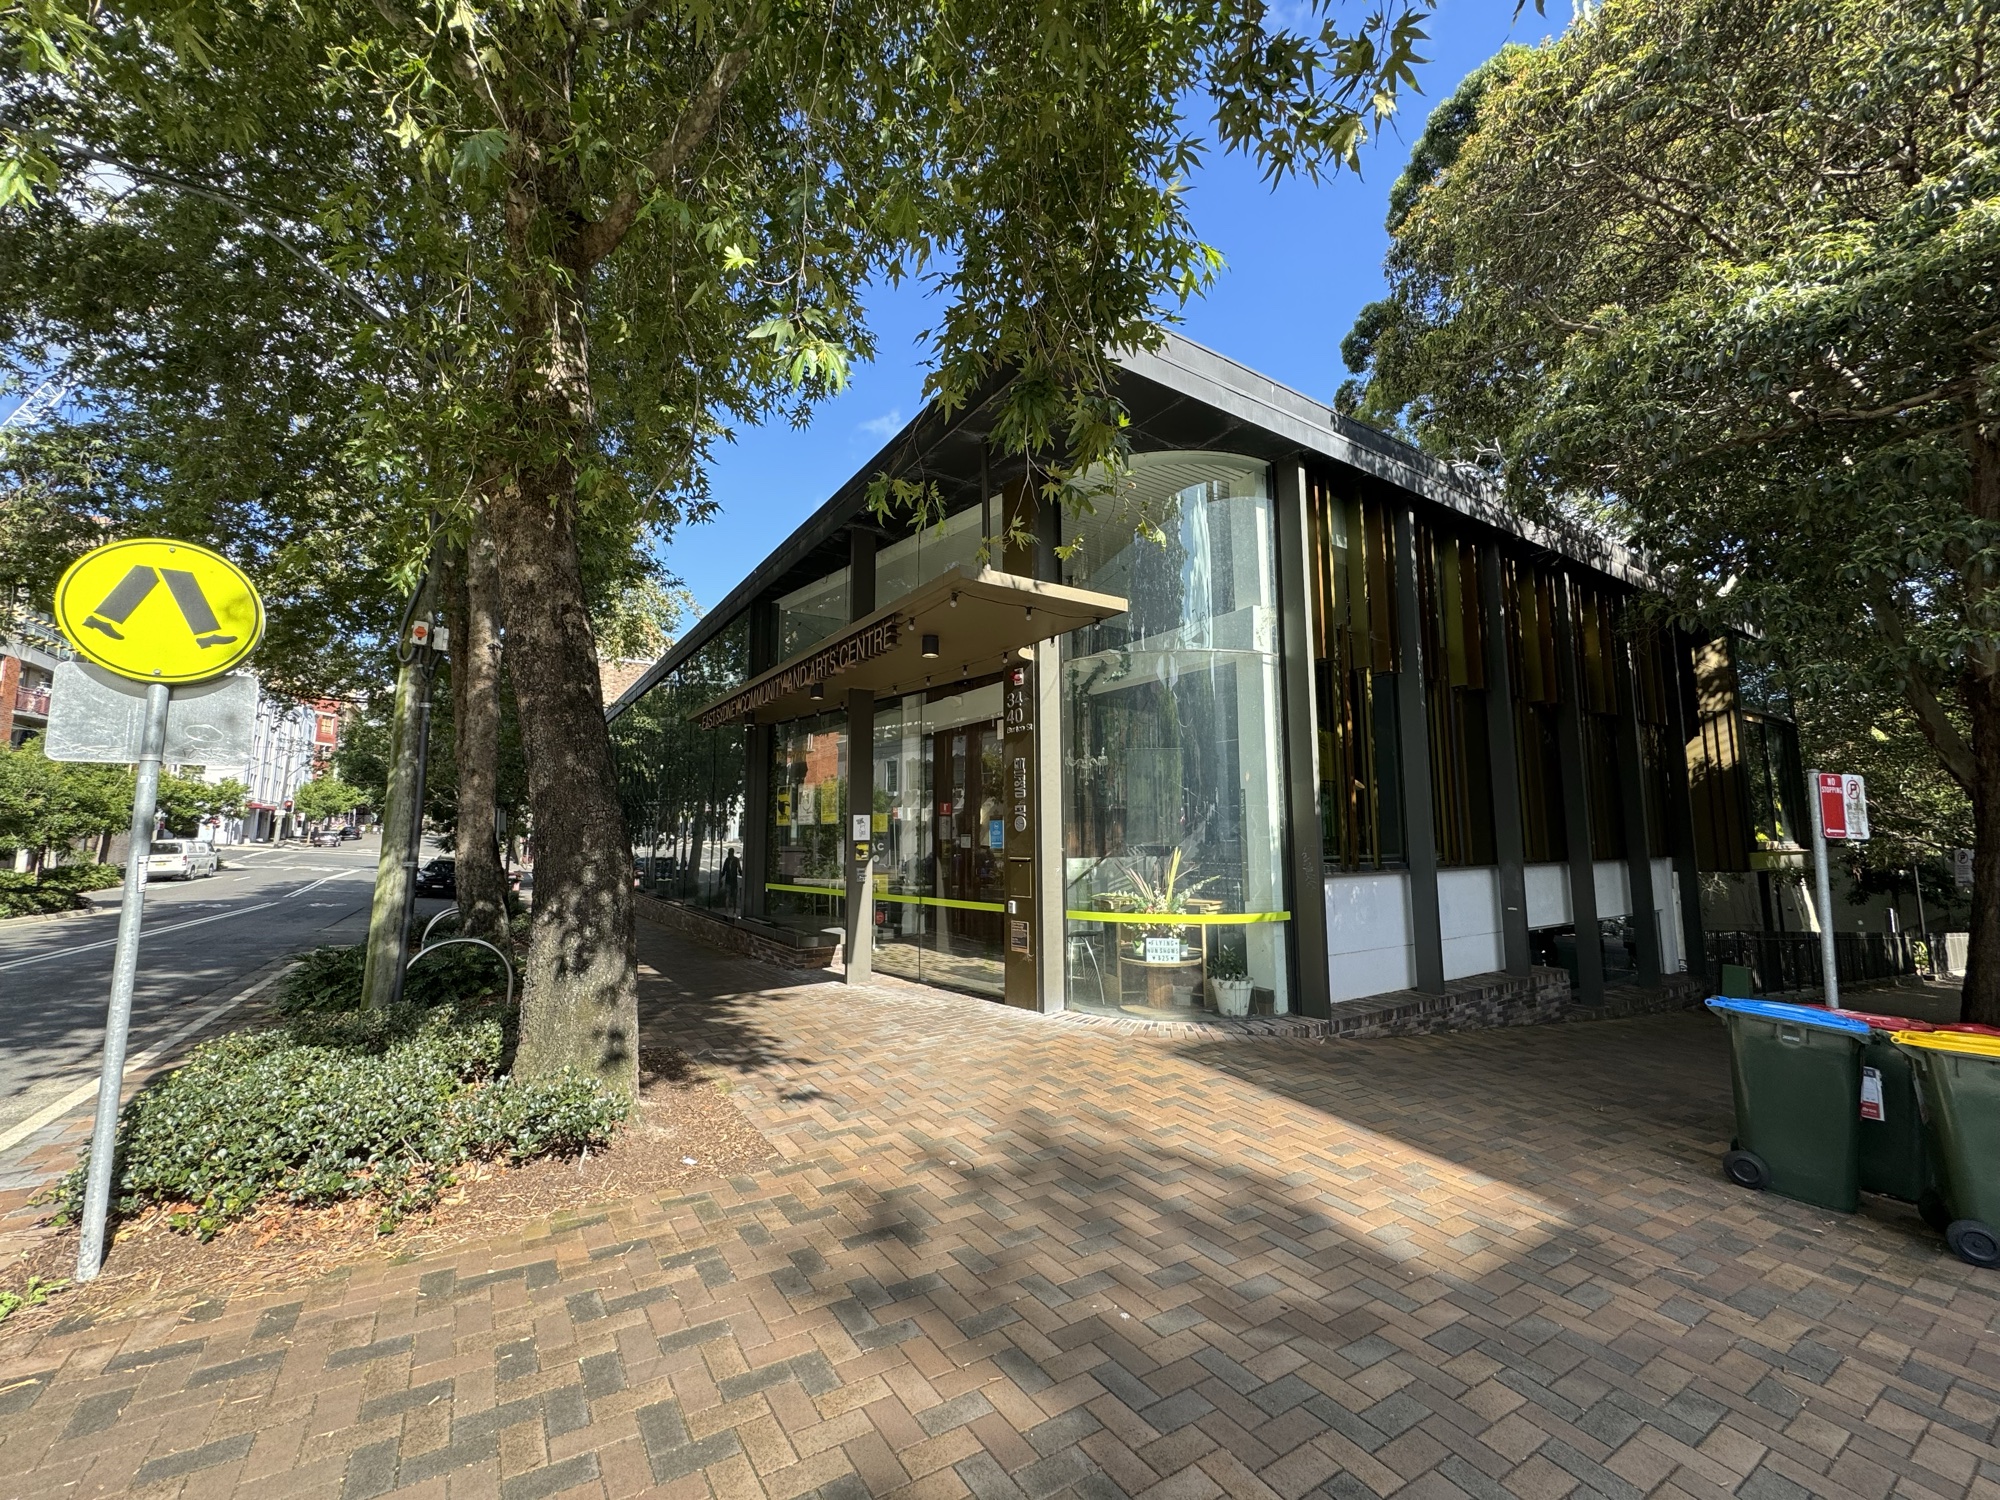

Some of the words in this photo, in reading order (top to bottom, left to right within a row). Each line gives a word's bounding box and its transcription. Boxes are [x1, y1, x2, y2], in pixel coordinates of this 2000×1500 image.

[786, 664, 807, 693] AND
[809, 650, 837, 681] ARTS
[839, 622, 892, 668] CENTRE
[1006, 707, 1023, 724] 40
[1827, 778, 1836, 786] NO
[1821, 786, 1843, 794] STOPPING
